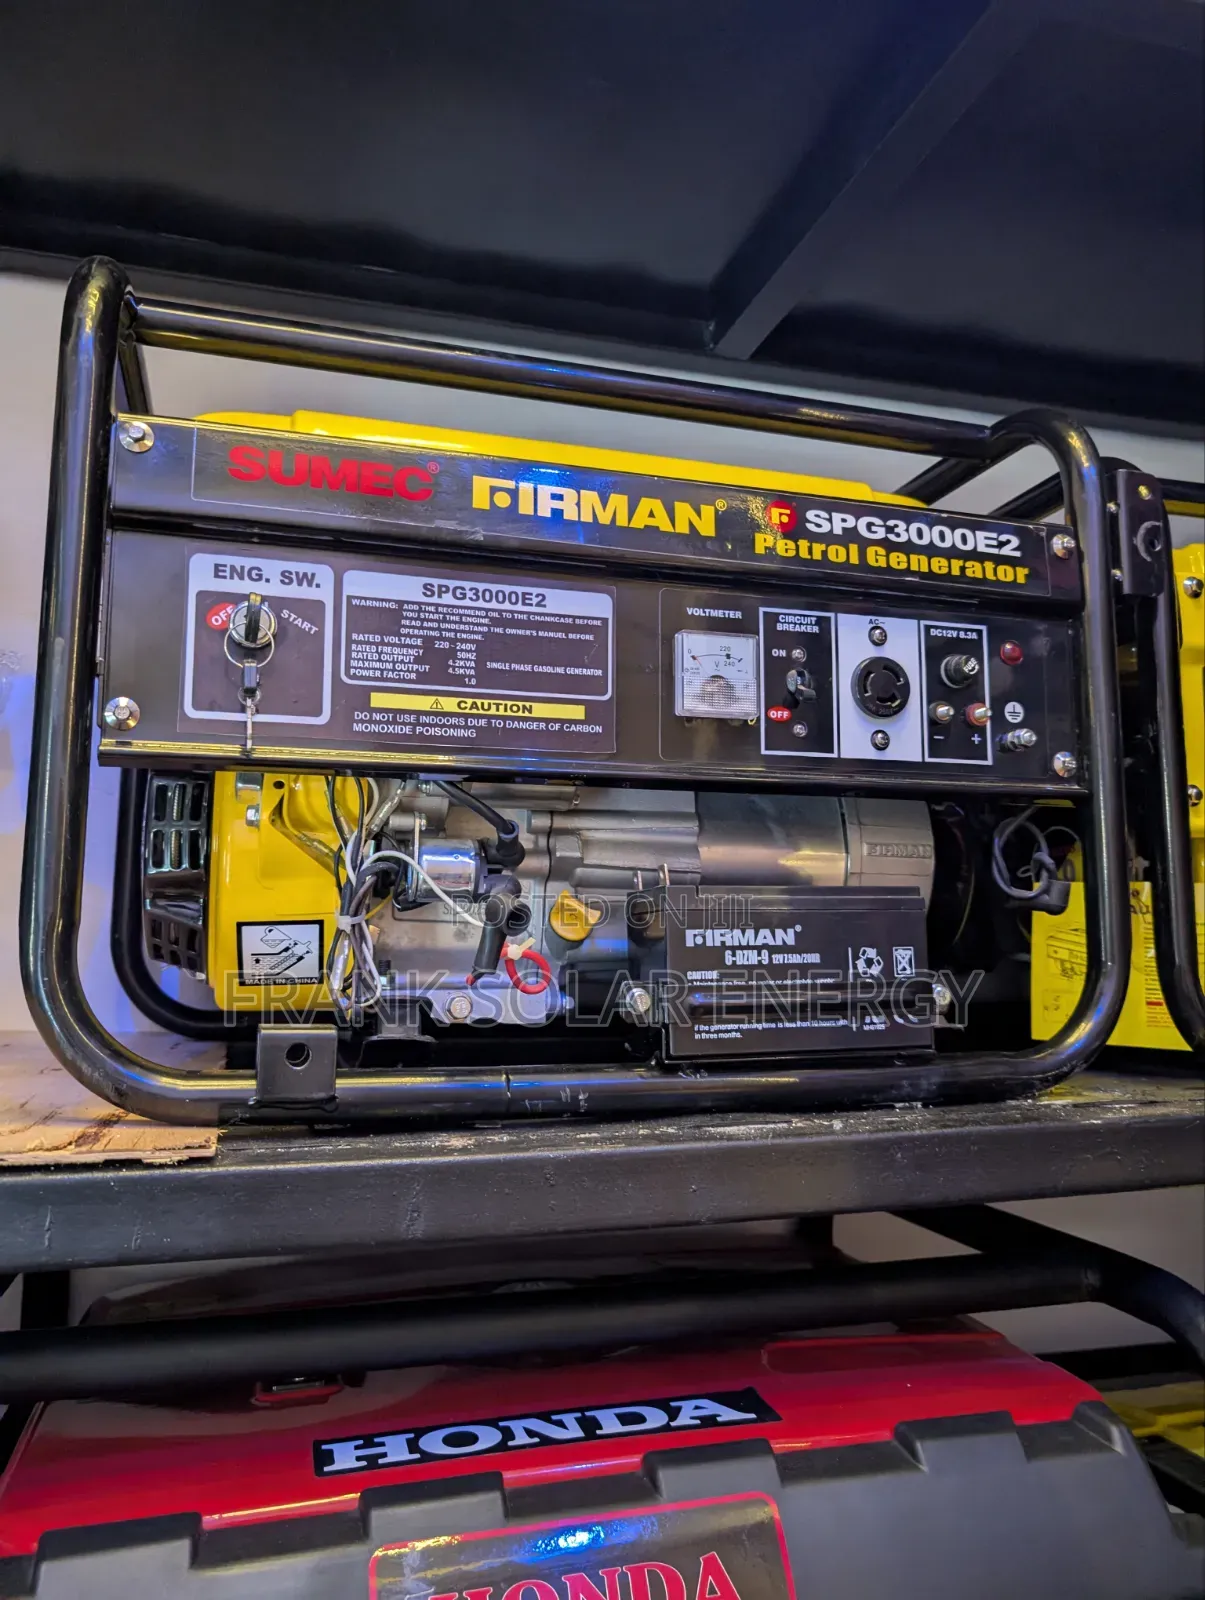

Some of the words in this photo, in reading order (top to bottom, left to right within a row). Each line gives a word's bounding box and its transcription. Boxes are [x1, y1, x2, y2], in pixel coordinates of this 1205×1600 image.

[805, 509, 1022, 558] SPG3000E2
[754, 532, 860, 565] Petrol
[866, 546, 1029, 584] Generator
[213, 563, 271, 583] ENG.
[279, 569, 321, 589] SW.
[422, 582, 547, 608] SPG3000E2
[351, 598, 399, 609] WARNING:
[402, 603, 419, 611] ADD
[421, 604, 436, 612] THE
[438, 606, 486, 616] RECOMMEND
[502, 611, 512, 619] TO
[575, 618, 603, 626] BEFORE
[420, 612, 443, 621] START
[445, 614, 460, 622] THE
[462, 616, 492, 625] ENGINE.
[686, 607, 743, 620] VOLTMETER
[778, 614, 818, 625] CIRCUIT
[280, 609, 319, 635] START
[401, 619, 421, 627] READ
[423, 620, 439, 628] AND
[440, 622, 488, 632] UNDERSTAND
[490, 626, 504, 634] THE
[505, 628, 537, 637] OWNER'S
[538, 630, 567, 639] MANUEL
[568, 633, 595, 641] BEFORE
[776, 623, 820, 634] BREAKER
[351, 633, 381, 642] RATED
[383, 635, 424, 646] VOLTAGE
[400, 627, 440, 637] OPERATING
[457, 632, 485, 641] ENGINE.
[930, 628, 957, 638] DC12V
[351, 643, 377, 653] RATED
[378, 645, 424, 656] FREQUENCY
[456, 651, 477, 660] 50HZ
[351, 651, 379, 660] RATED
[380, 653, 415, 663] OUTPUT
[447, 660, 476, 668] 4.2KVA
[771, 648, 787, 657] ON
[350, 660, 394, 669] MAXIMUM
[395, 663, 431, 672] OUTPUT
[447, 667, 476, 676] 4.5KVA
[486, 661, 510, 671] SINGLE
[511, 663, 533, 672] PHASE
[533, 665, 566, 675] GASOLINE
[566, 667, 603, 677] GENERATOR
[963, 657, 978, 674] FUSE
[350, 668, 381, 677] POWER
[383, 670, 417, 680] FACTOR
[464, 677, 477, 685] 1.0
[456, 700, 533, 715] CAUTION
[769, 710, 789, 719] OFF
[354, 711, 370, 720] DO
[372, 712, 394, 722] NOT
[396, 714, 417, 723] USE
[419, 715, 466, 726] INDOORS
[467, 718, 488, 727] DUE
[490, 719, 504, 728] TO
[505, 720, 546, 731] DANGER
[548, 723, 562, 731] OF
[563, 724, 603, 733] CARBON
[352, 723, 413, 735] MONOXIDE
[415, 726, 477, 738] POISONING
[724, 949, 769, 966] 6-DZM-9
[710, 1023, 740, 1032] generator
[321, 1397, 757, 1472] HONDA
